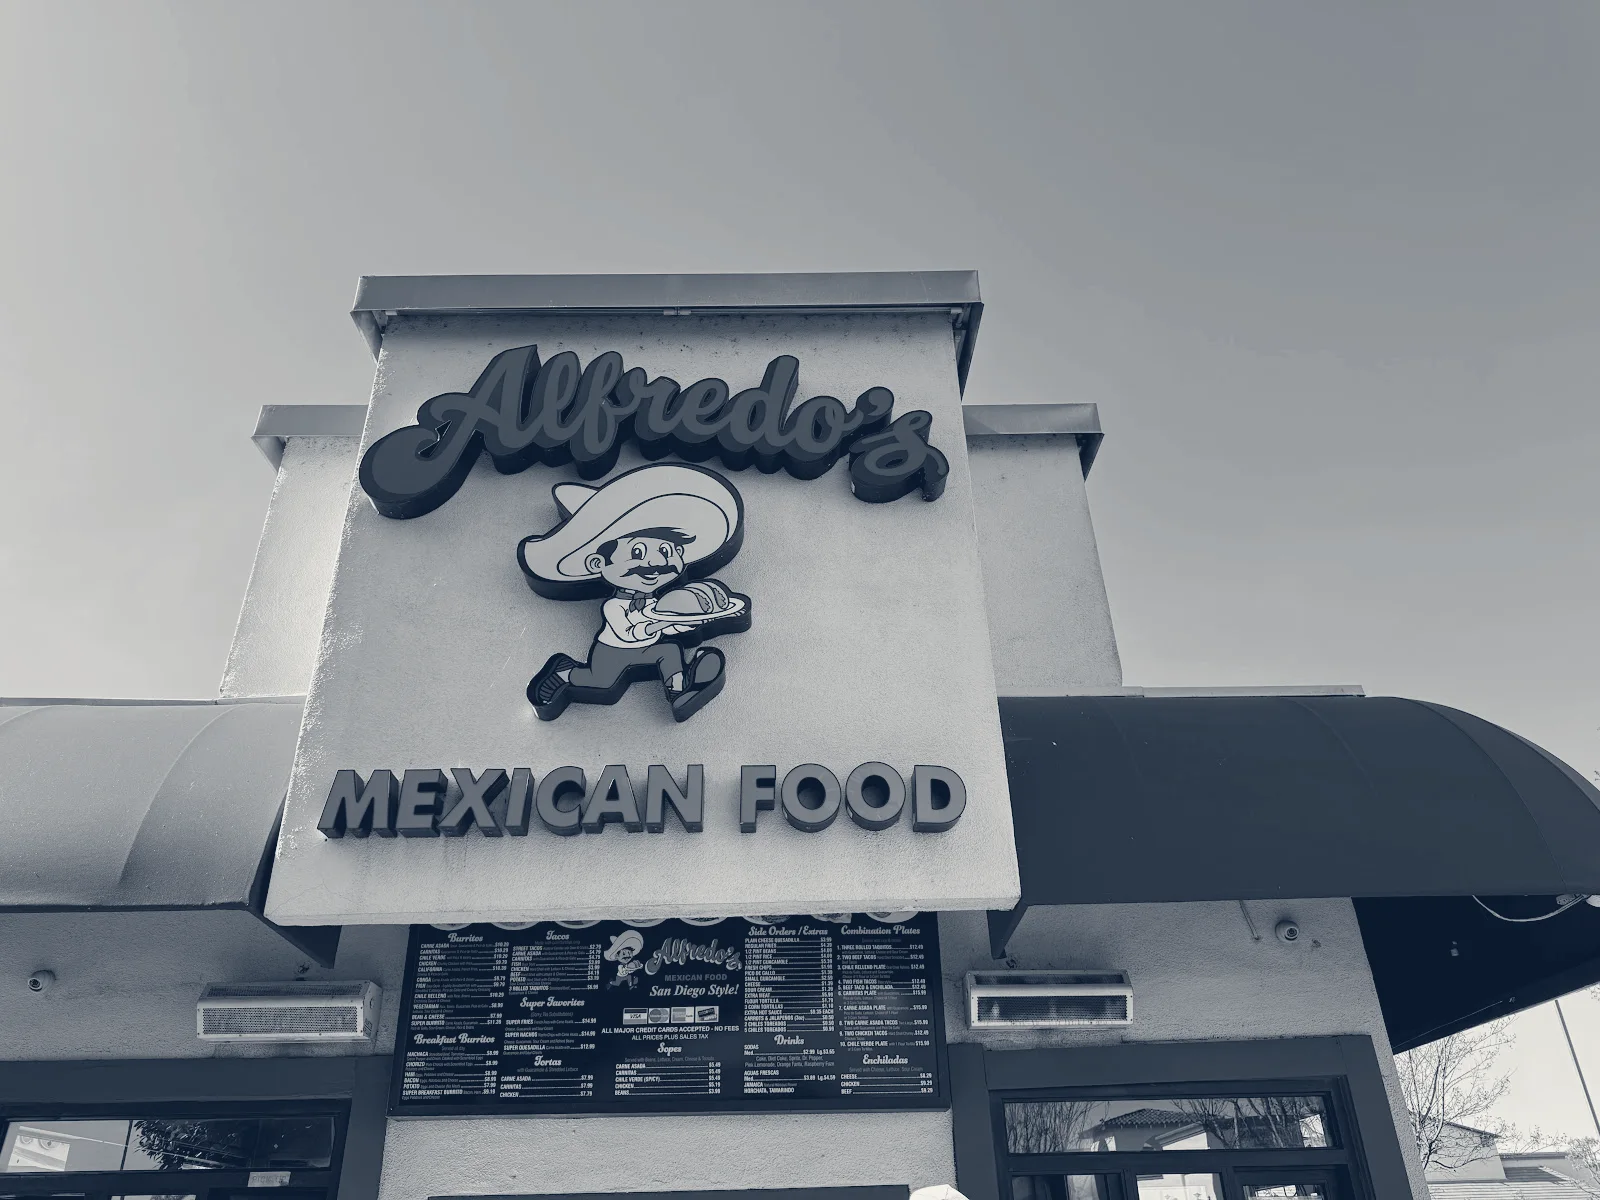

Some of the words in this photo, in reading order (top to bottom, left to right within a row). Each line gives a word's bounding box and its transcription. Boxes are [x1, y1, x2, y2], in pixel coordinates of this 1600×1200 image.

[359, 345, 949, 518] Alfredo's
[317, 764, 704, 838] MEXICAN
[739, 762, 966, 833] FOOD
[546, 930, 569, 940] Tacos
[748, 926, 766, 936] Side
[769, 926, 796, 936] Orders
[803, 926, 828, 935] Extras
[841, 925, 891, 935] Combination
[893, 925, 920, 934] Plates
[448, 933, 483, 942] Burritos
[645, 937, 742, 975] Alfredo's
[650, 986, 671, 996] San
[674, 985, 705, 998] Diego
[708, 984, 739, 997] Style!
[520, 997, 545, 1011] Super
[547, 996, 585, 1006] Favorites
[414, 1034, 456, 1045] Breakfast
[458, 1033, 495, 1043] Burritos
[774, 1034, 804, 1045] Drinks
[658, 1042, 682, 1056] Sopes
[534, 1056, 562, 1066] Tortas
[863, 1054, 908, 1064] Enchiladas
